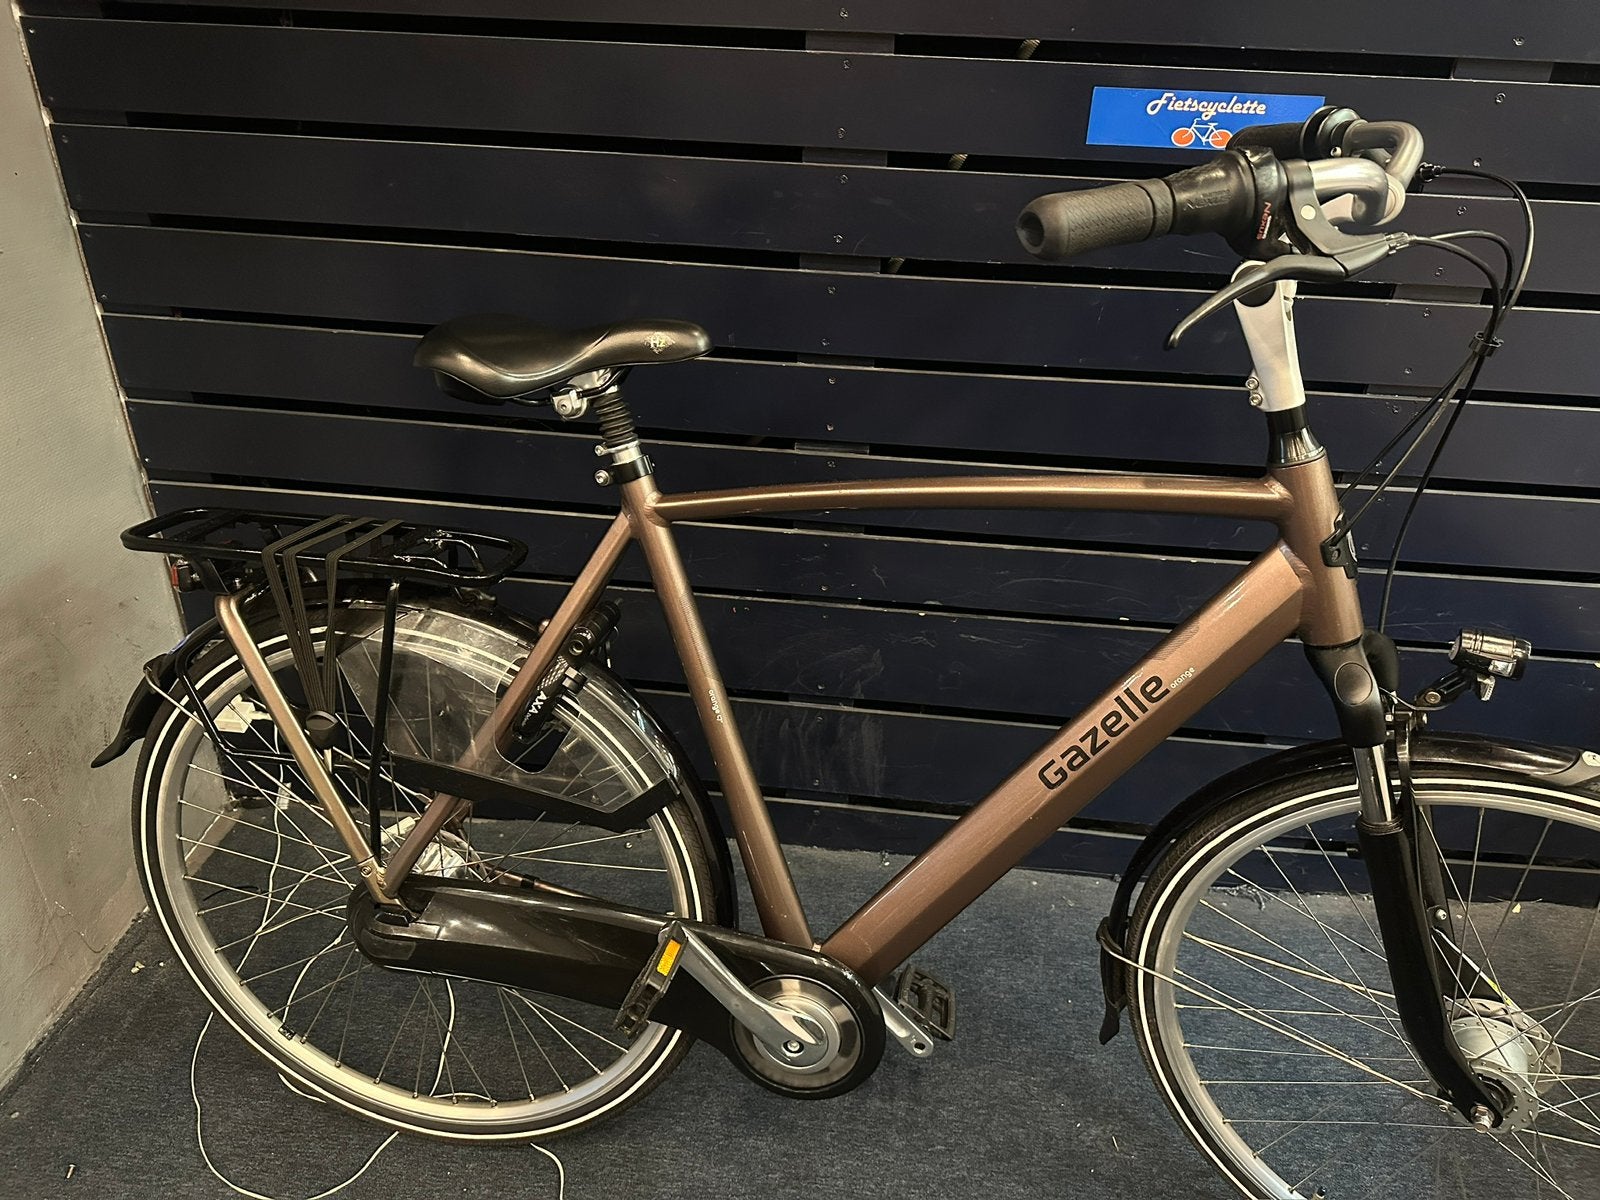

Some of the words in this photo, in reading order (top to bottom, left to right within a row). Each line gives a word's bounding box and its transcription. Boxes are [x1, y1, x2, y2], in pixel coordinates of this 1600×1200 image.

[1146, 92, 1267, 121] Fietscyclette
[1170, 667, 1195, 689] orange
[528, 690, 547, 714] AXA
[708, 689, 720, 714] orange
[1038, 675, 1171, 790] Gazelle
